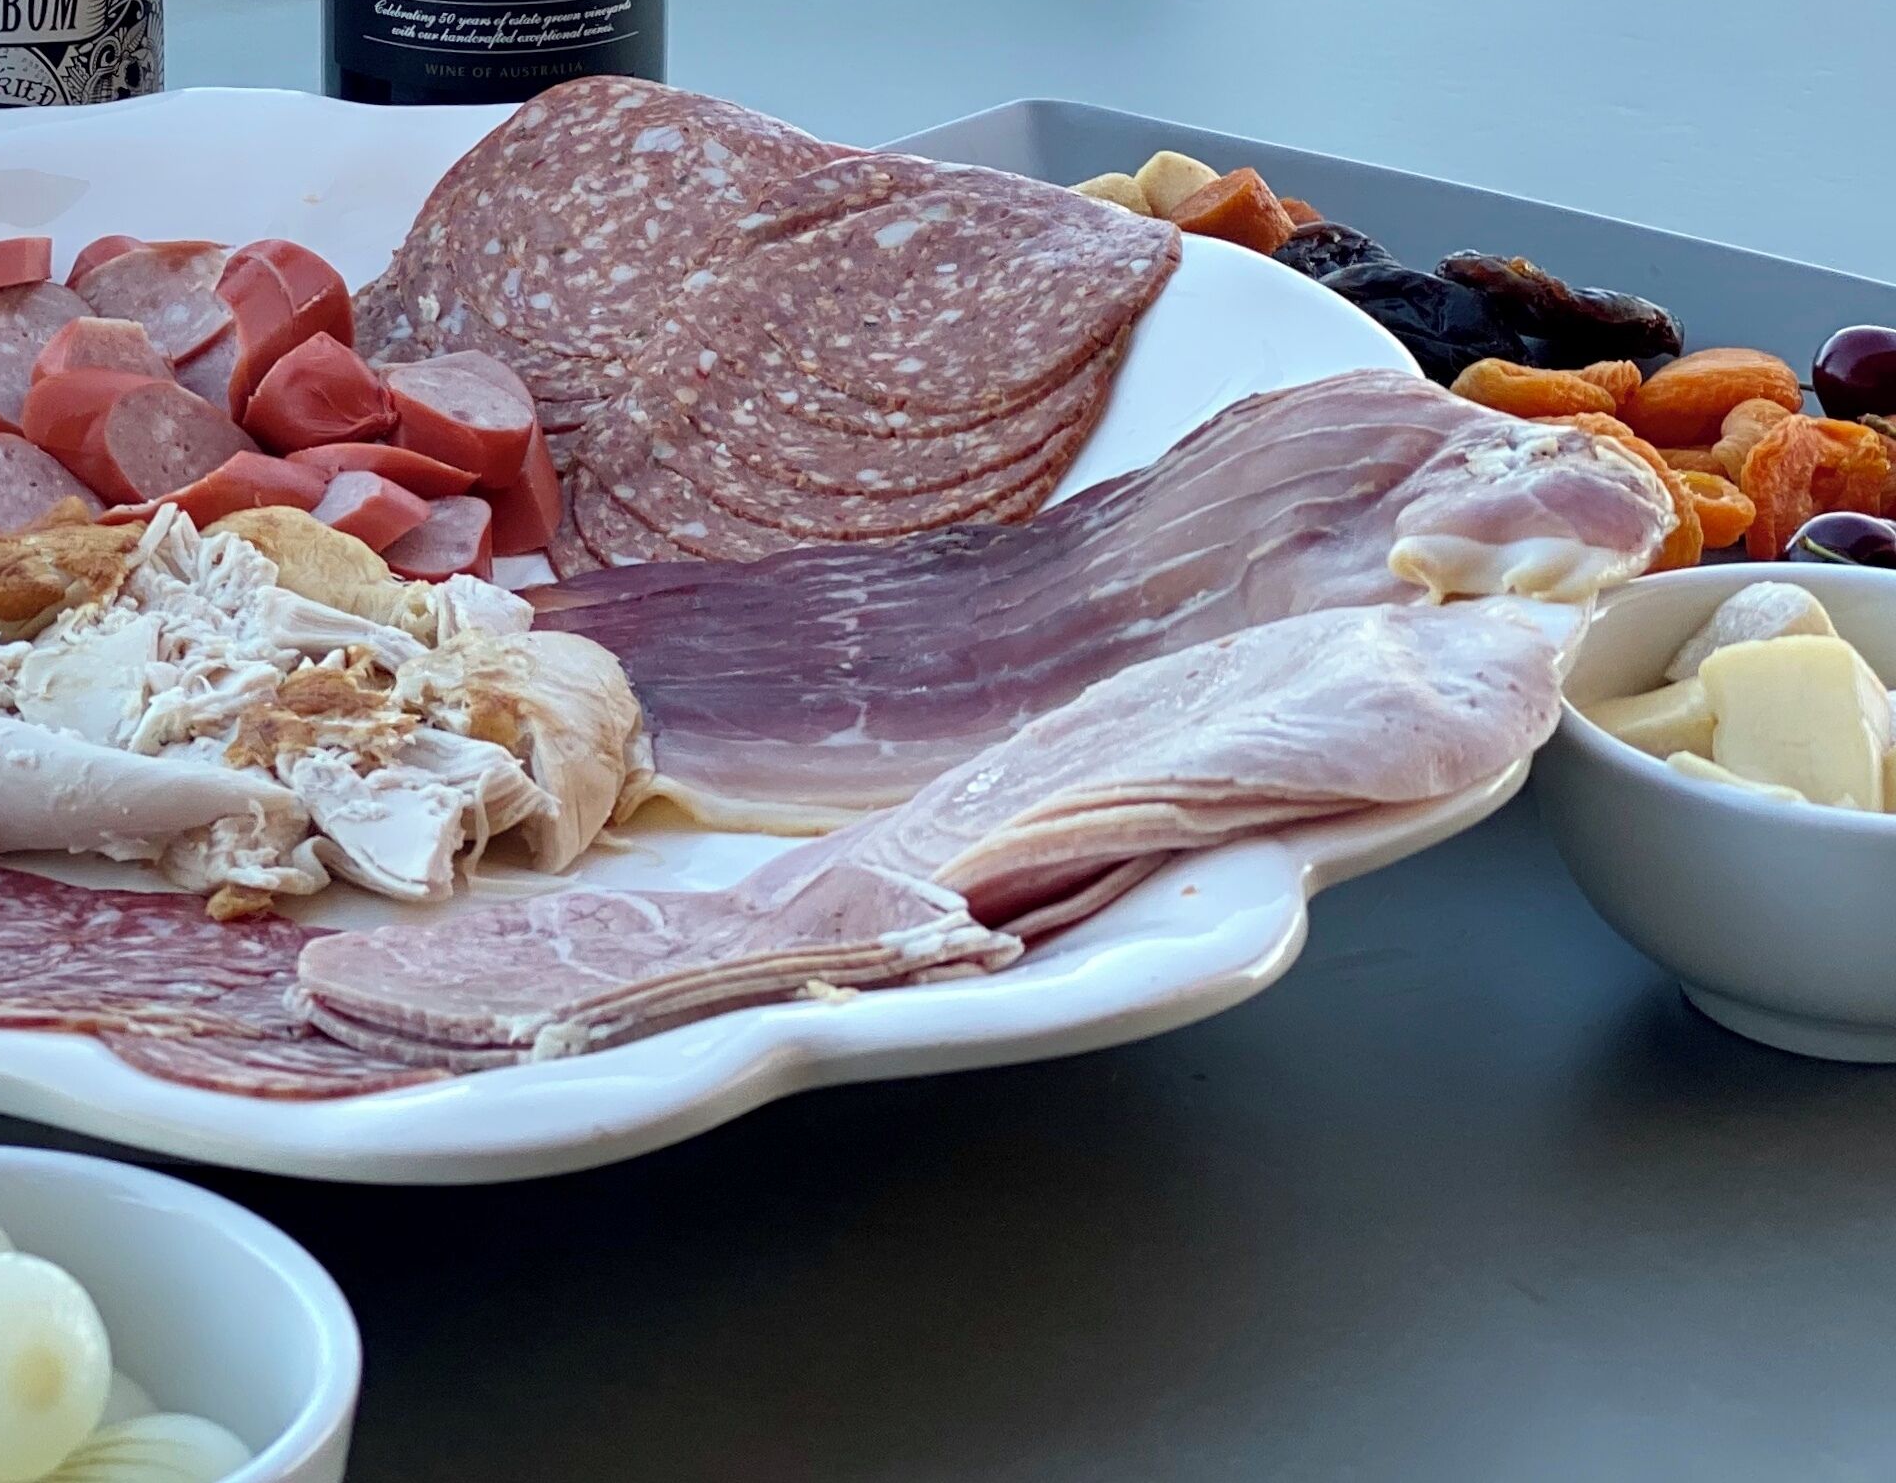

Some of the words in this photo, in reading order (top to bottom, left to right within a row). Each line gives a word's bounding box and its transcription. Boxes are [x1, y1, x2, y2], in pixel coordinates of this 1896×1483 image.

[374, 0, 437, 28] Celebrating
[439, 12, 455, 25] 50
[457, 14, 492, 33] years
[493, 12, 512, 34] of
[509, 12, 543, 26] estate
[541, 13, 581, 30] grown
[391, 25, 416, 39] with
[417, 31, 440, 42] our
[440, 29, 518, 50] handcrafted
[517, 24, 584, 47] exceptional
[425, 63, 466, 78] WINE
[472, 65, 493, 79] OF
[498, 62, 585, 79] AUSTRALIA
